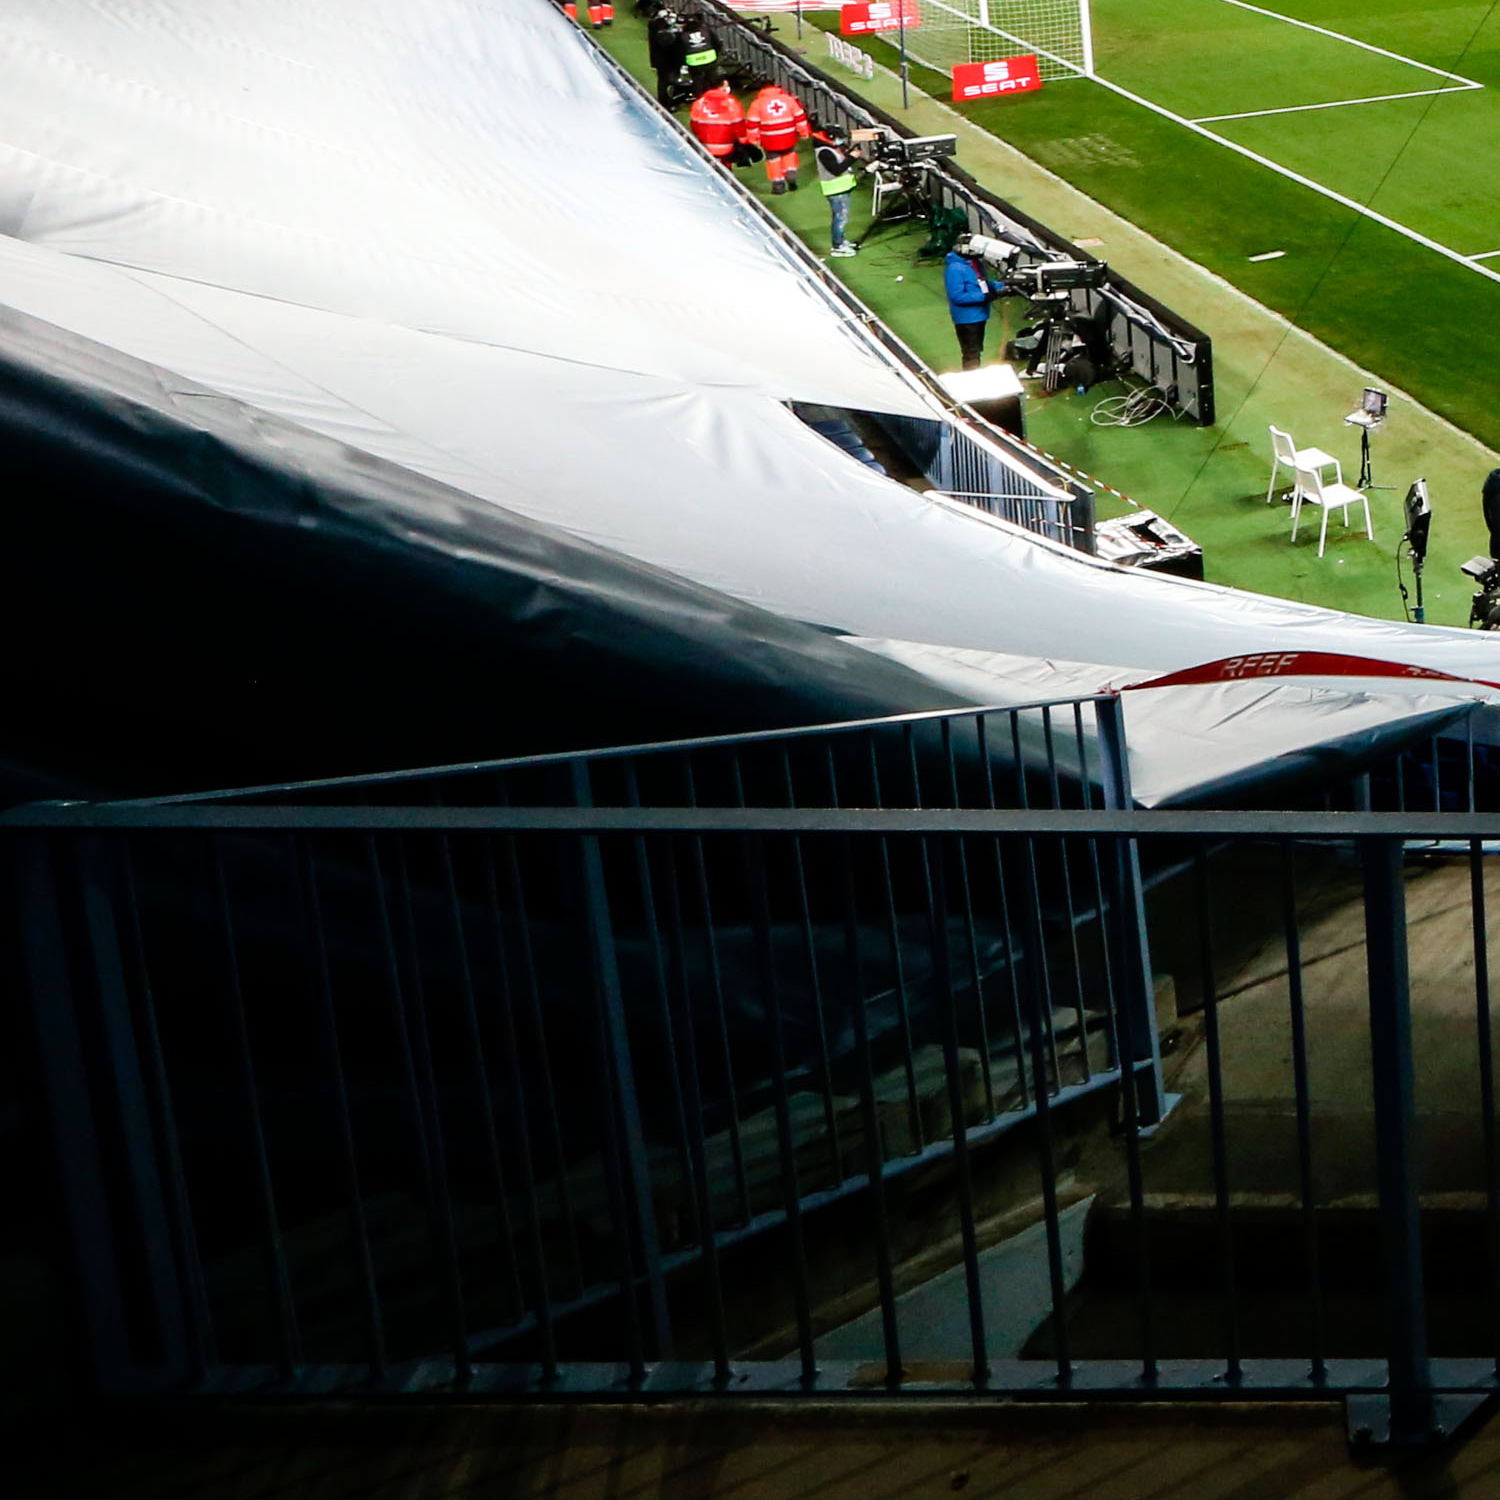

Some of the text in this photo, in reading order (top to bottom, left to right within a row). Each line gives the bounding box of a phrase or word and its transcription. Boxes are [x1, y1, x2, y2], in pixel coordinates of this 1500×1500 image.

[850, 16, 914, 30] SEAT
[964, 77, 1031, 96] SEAT
[1219, 653, 1301, 677] RFEF
